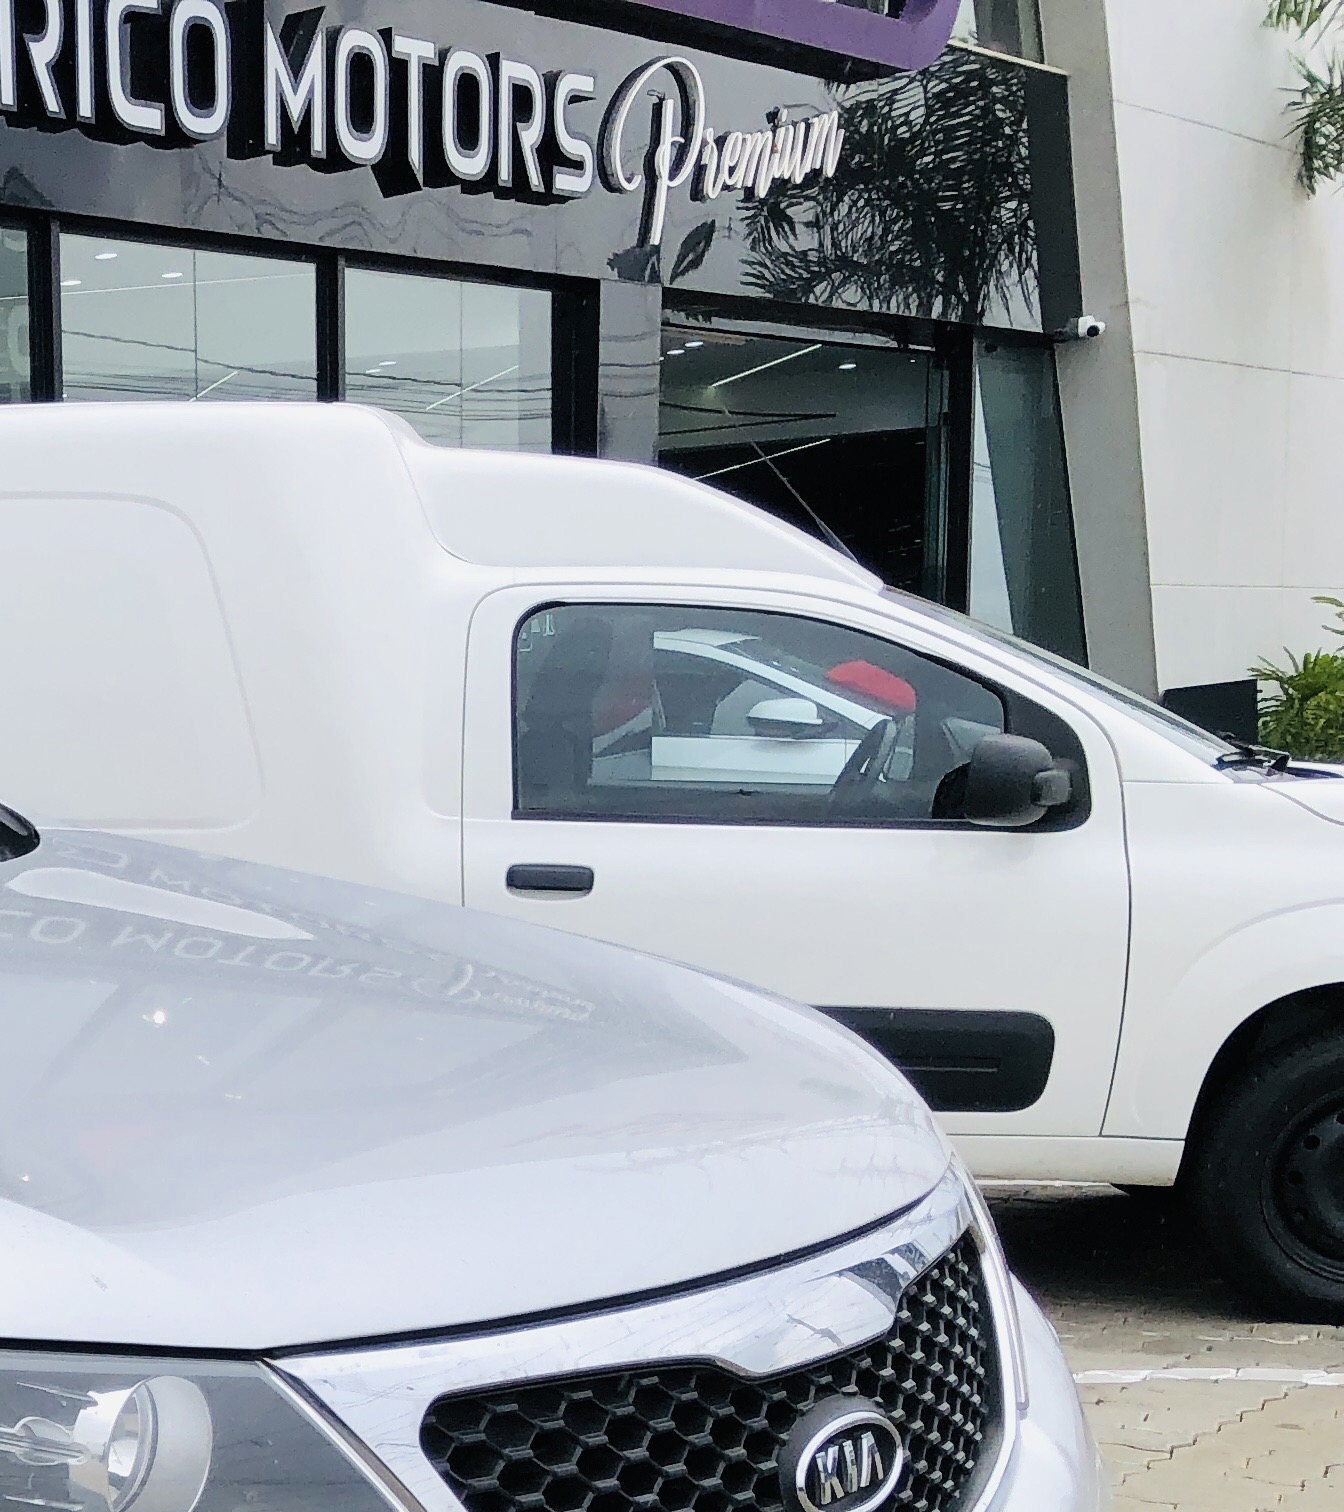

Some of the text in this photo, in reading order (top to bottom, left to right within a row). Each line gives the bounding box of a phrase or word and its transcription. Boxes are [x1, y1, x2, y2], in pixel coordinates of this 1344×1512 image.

[263, 22, 596, 199] MOTORS
[610, 55, 844, 247] Premium
[814, 1430, 885, 1505] KIA
